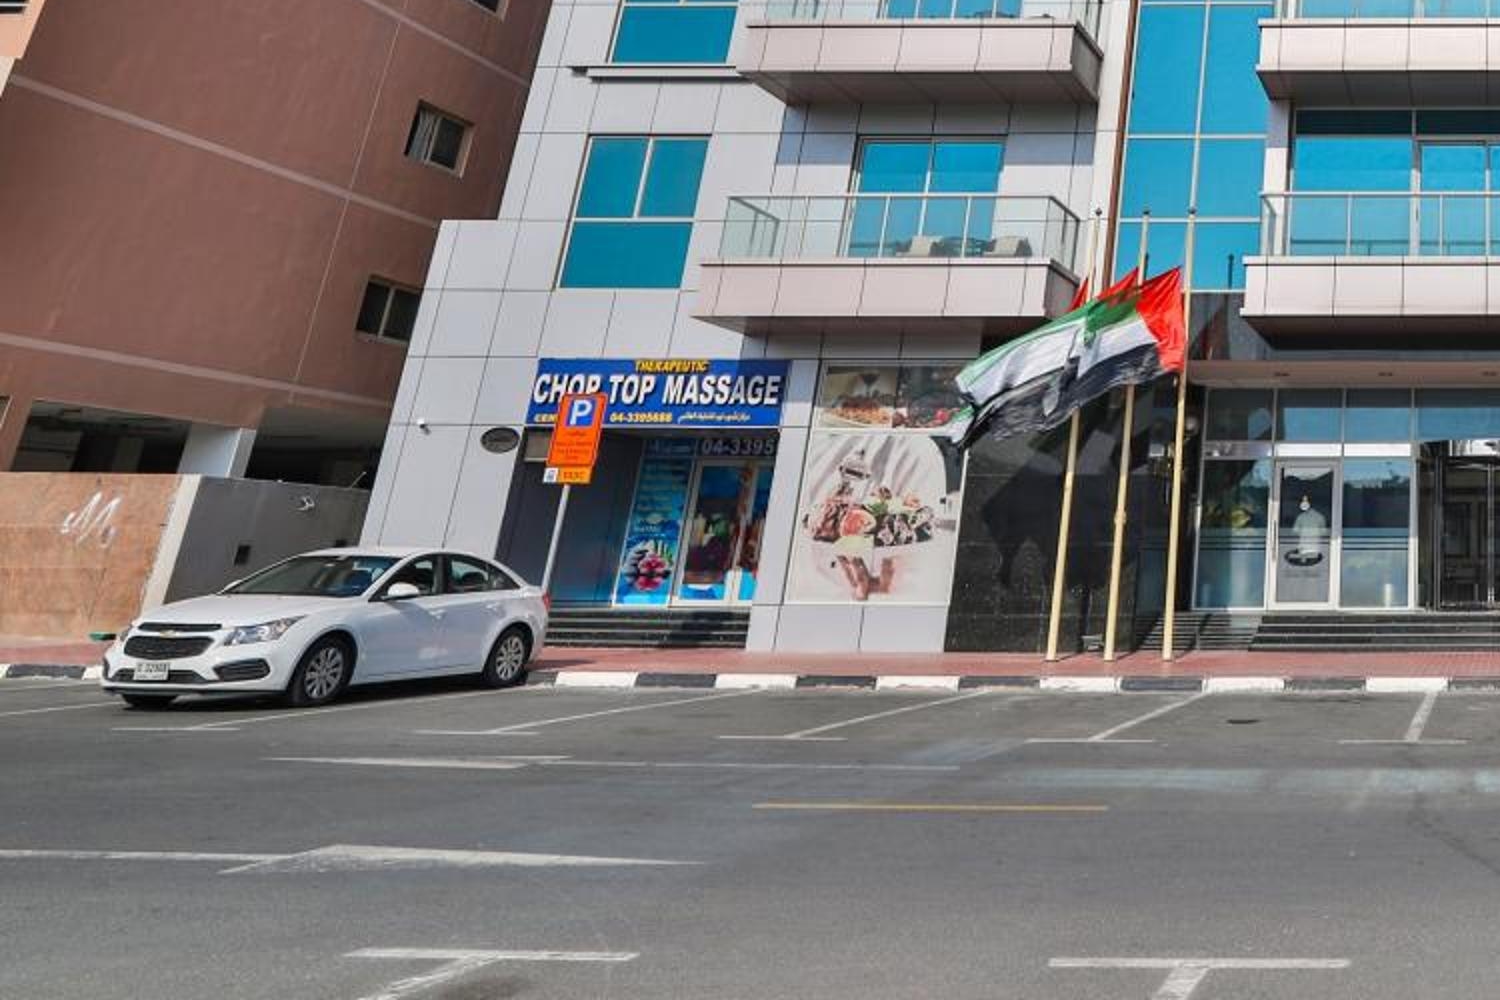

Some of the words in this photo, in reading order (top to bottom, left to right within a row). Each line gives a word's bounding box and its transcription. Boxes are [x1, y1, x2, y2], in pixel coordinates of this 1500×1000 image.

[533, 373, 601, 404] CHOP
[608, 375, 655, 406] TOP
[661, 375, 782, 406] MASSAGE
[569, 400, 593, 426] P
